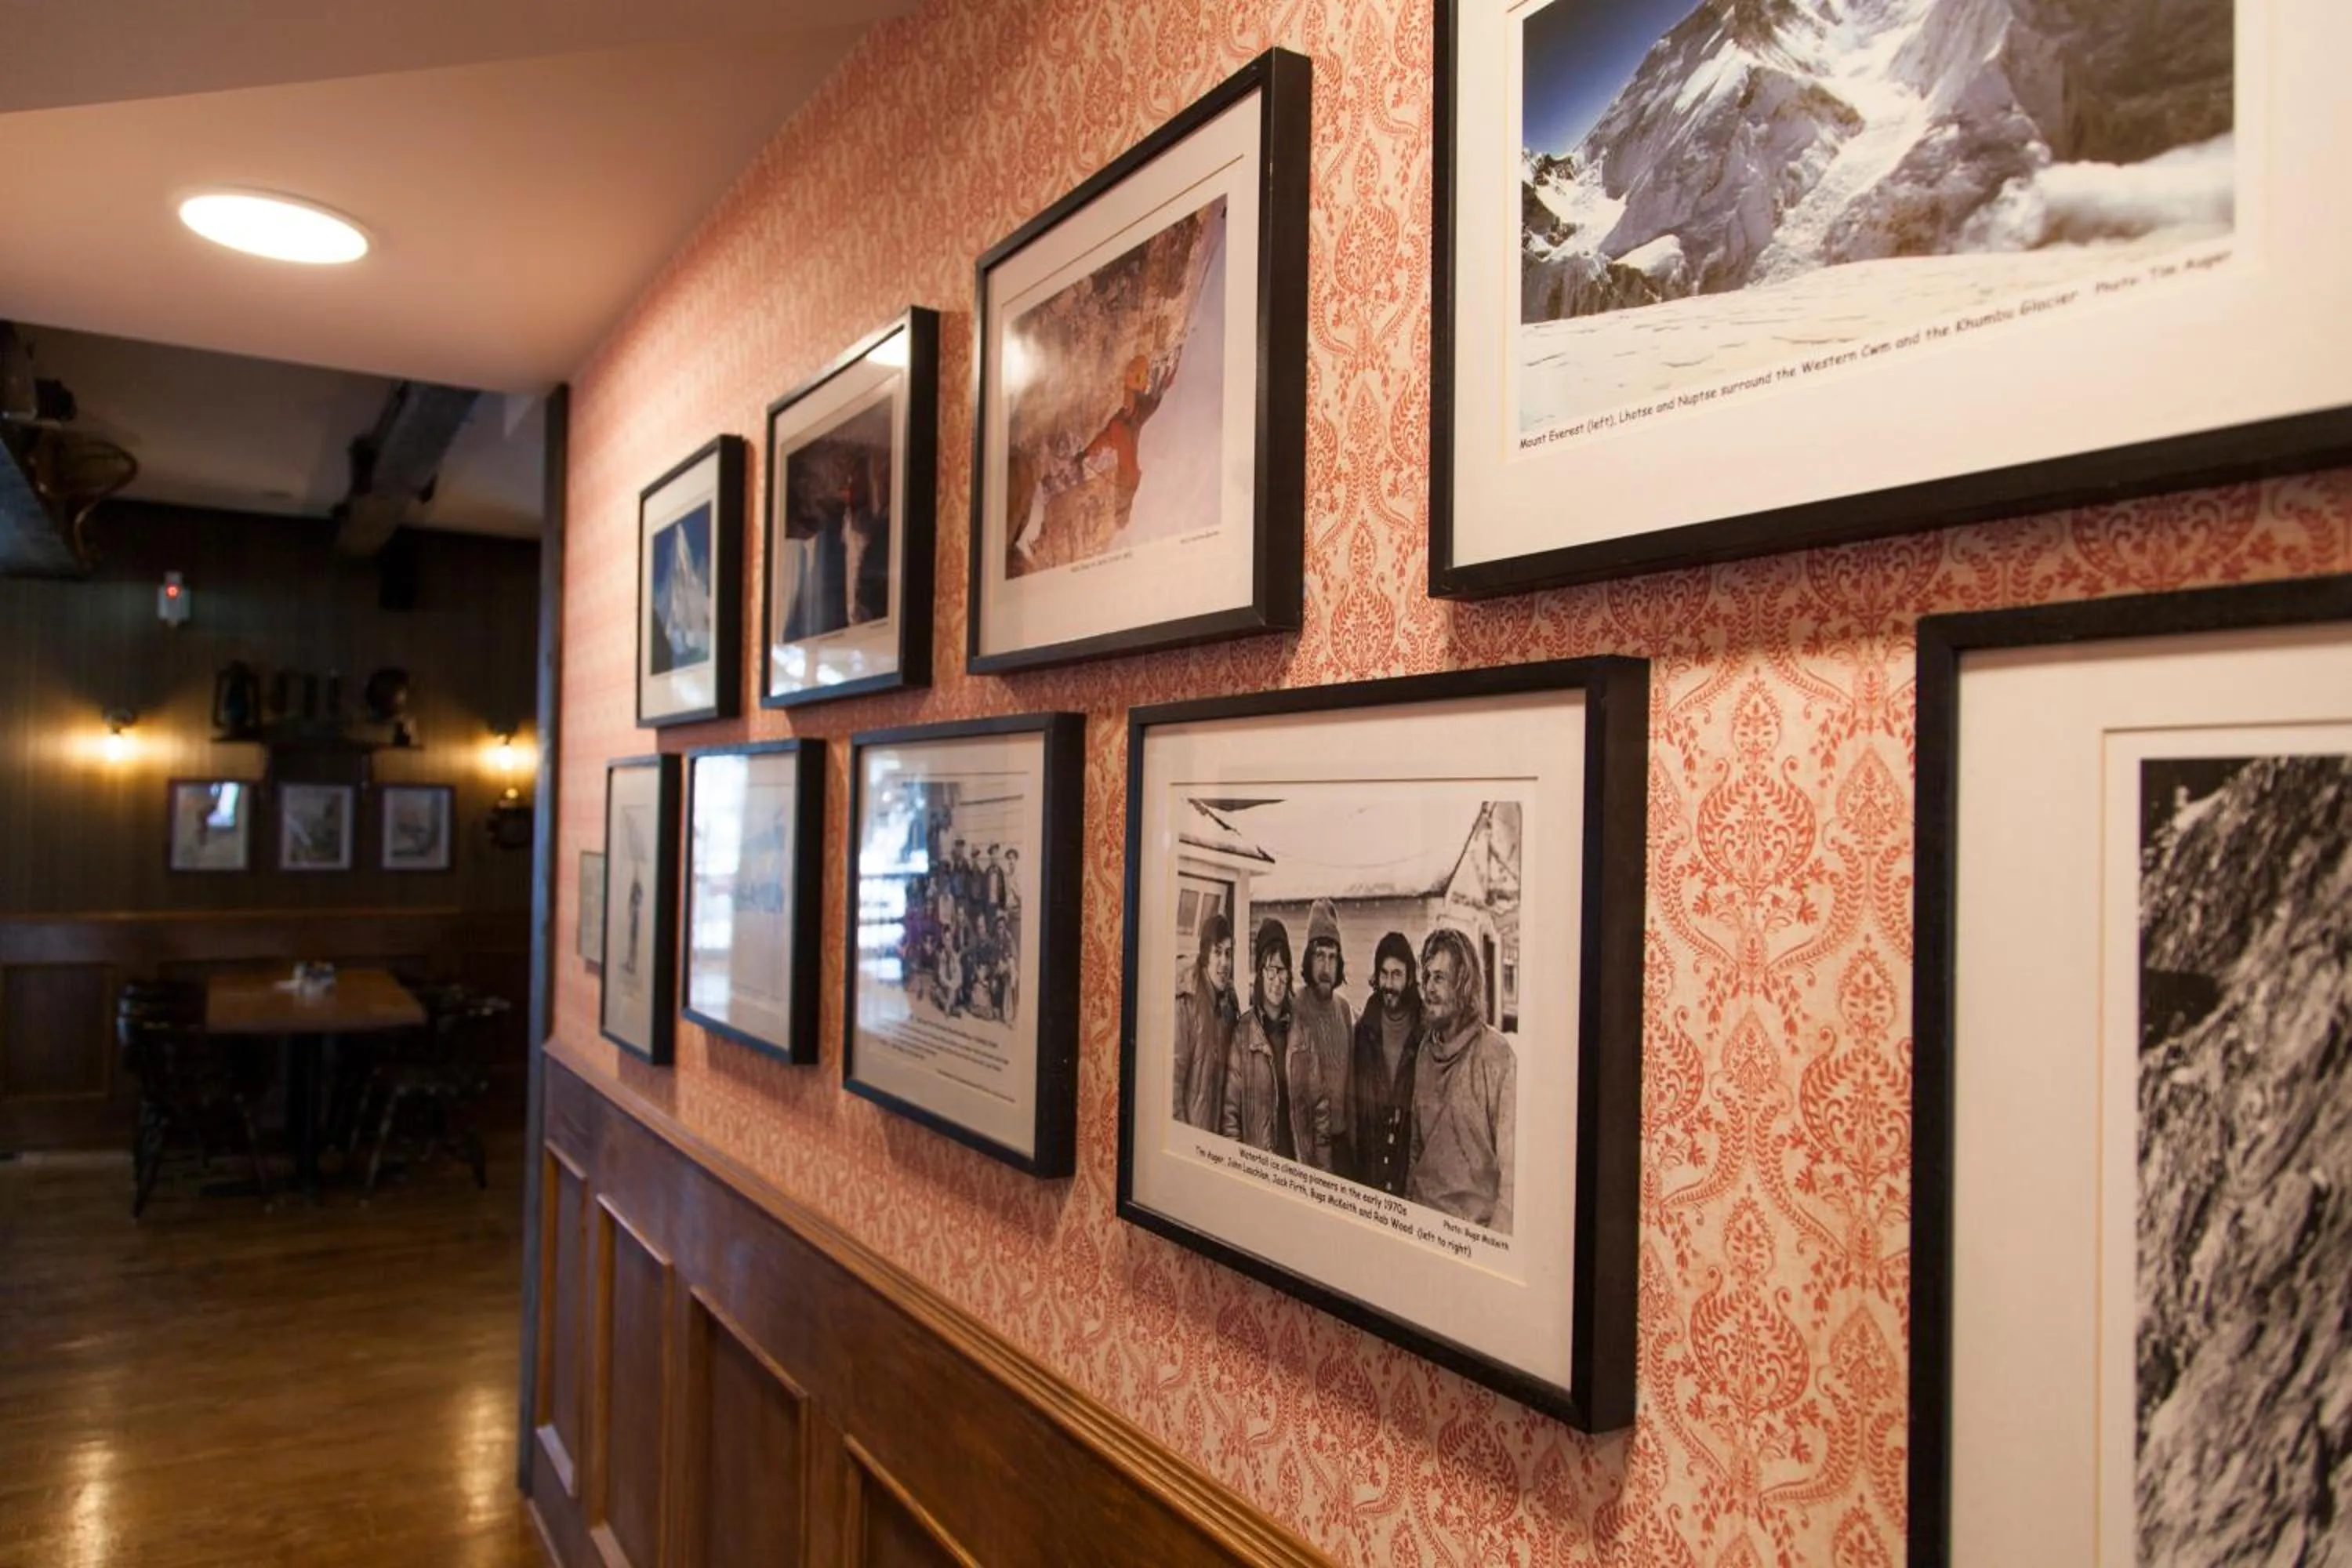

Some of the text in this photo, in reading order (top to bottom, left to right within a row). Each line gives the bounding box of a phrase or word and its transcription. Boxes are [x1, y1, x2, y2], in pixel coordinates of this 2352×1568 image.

[1519, 433, 1546, 449] Mount
[1548, 423, 1584, 442] Everest
[1619, 402, 1653, 424] Lhotse
[1656, 397, 1675, 414] and
[1677, 389, 1717, 408] Nuptse
[1720, 375, 1772, 397] surround
[1776, 367, 1796, 381] the
[1801, 351, 1857, 372] Western
[1896, 332, 1921, 350] and
[1926, 325, 1951, 341] the
[1956, 309, 2014, 332] Khumbu
[2020, 290, 2079, 316] Glacier
[1270, 1158, 1279, 1170] ice
[1281, 1162, 1308, 1183] climbing
[1308, 1174, 1338, 1192] pioneers
[1340, 1182, 1347, 1193] in
[1348, 1187, 1361, 1200] the
[1363, 1195, 1381, 1210] early
[1384, 1198, 1407, 1216] 1970s
[1272, 1174, 1287, 1188] Jack
[1359, 1207, 1372, 1219] and
[1391, 1217, 1414, 1235] Wood
[1437, 1236, 1446, 1247] to
[1447, 1240, 1472, 1258] right)
